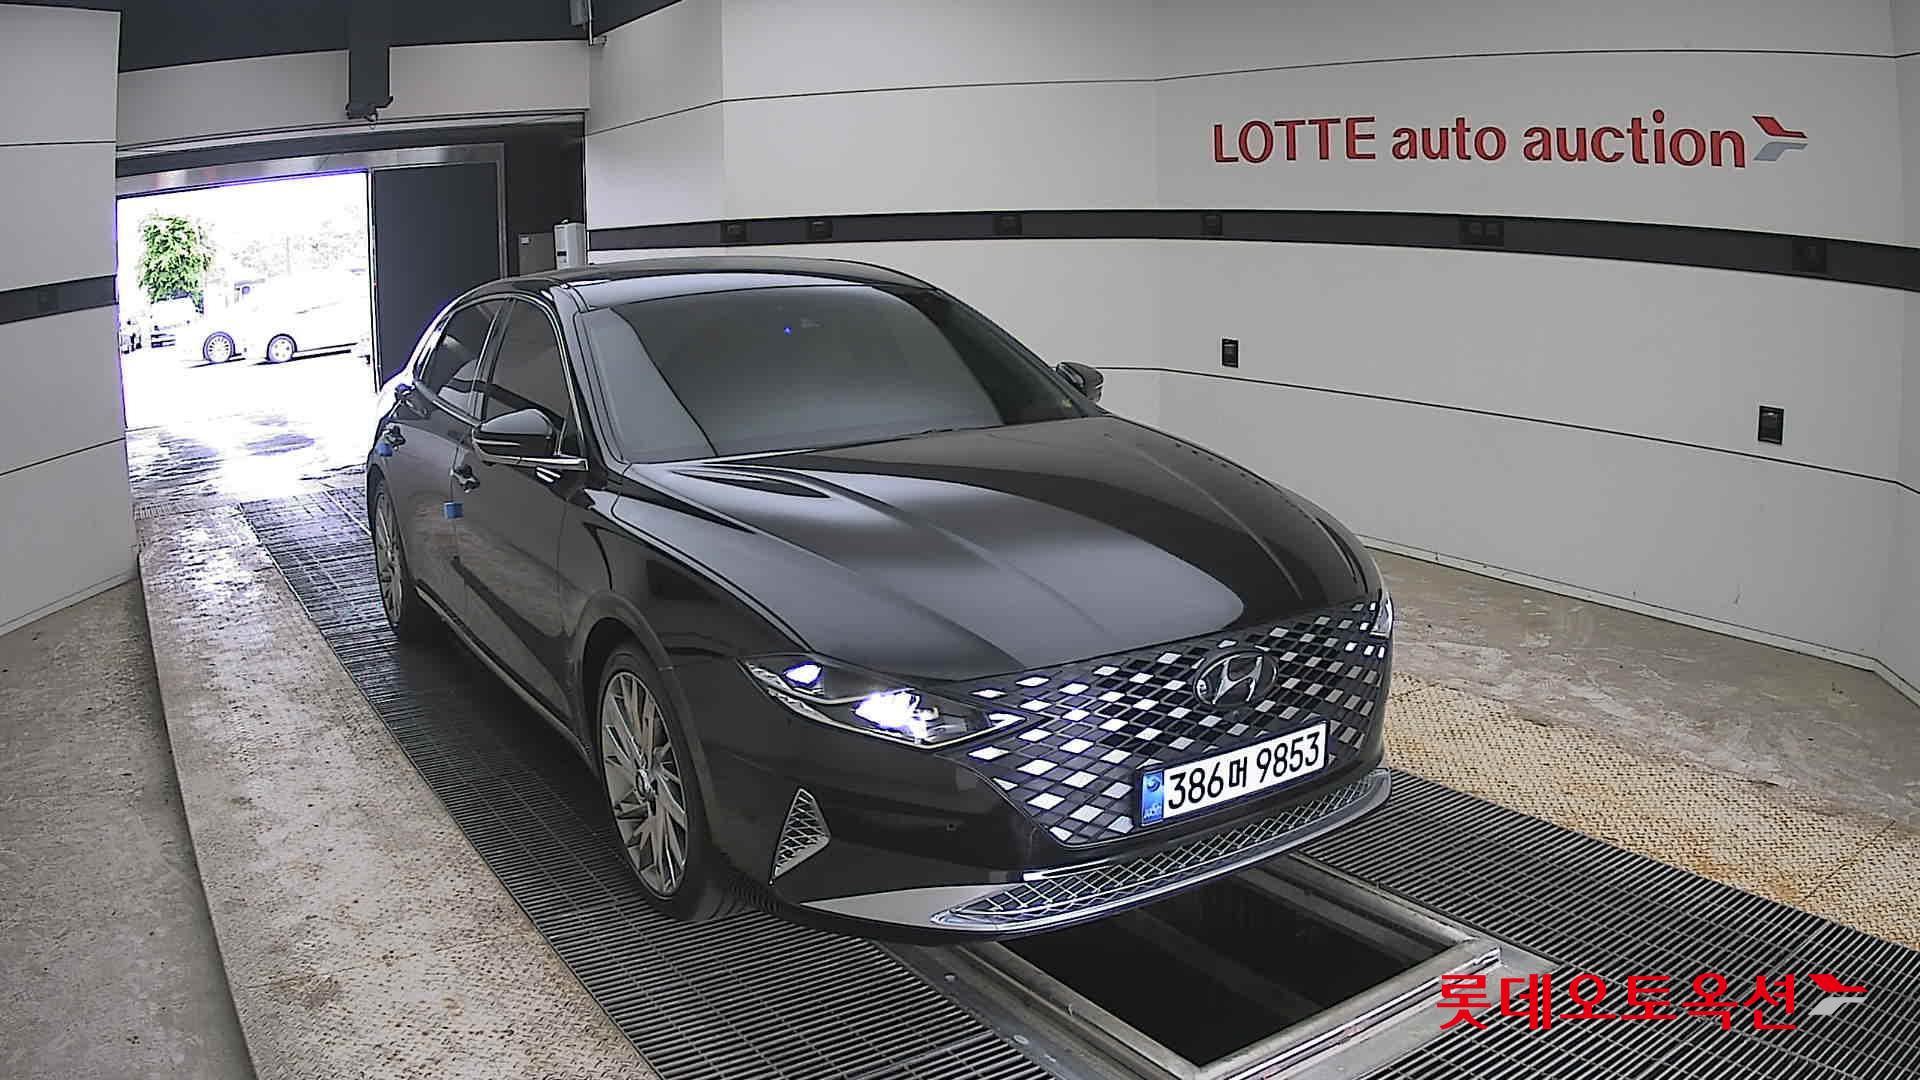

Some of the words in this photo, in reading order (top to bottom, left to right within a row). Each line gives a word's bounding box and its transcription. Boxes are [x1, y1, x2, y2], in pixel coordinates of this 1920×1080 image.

[1212, 116, 1376, 164] LOTTE
[1391, 116, 1507, 162] auto
[1522, 109, 1747, 168] auction
[1167, 755, 1249, 810] 386머
[1256, 731, 1321, 784] 9853
